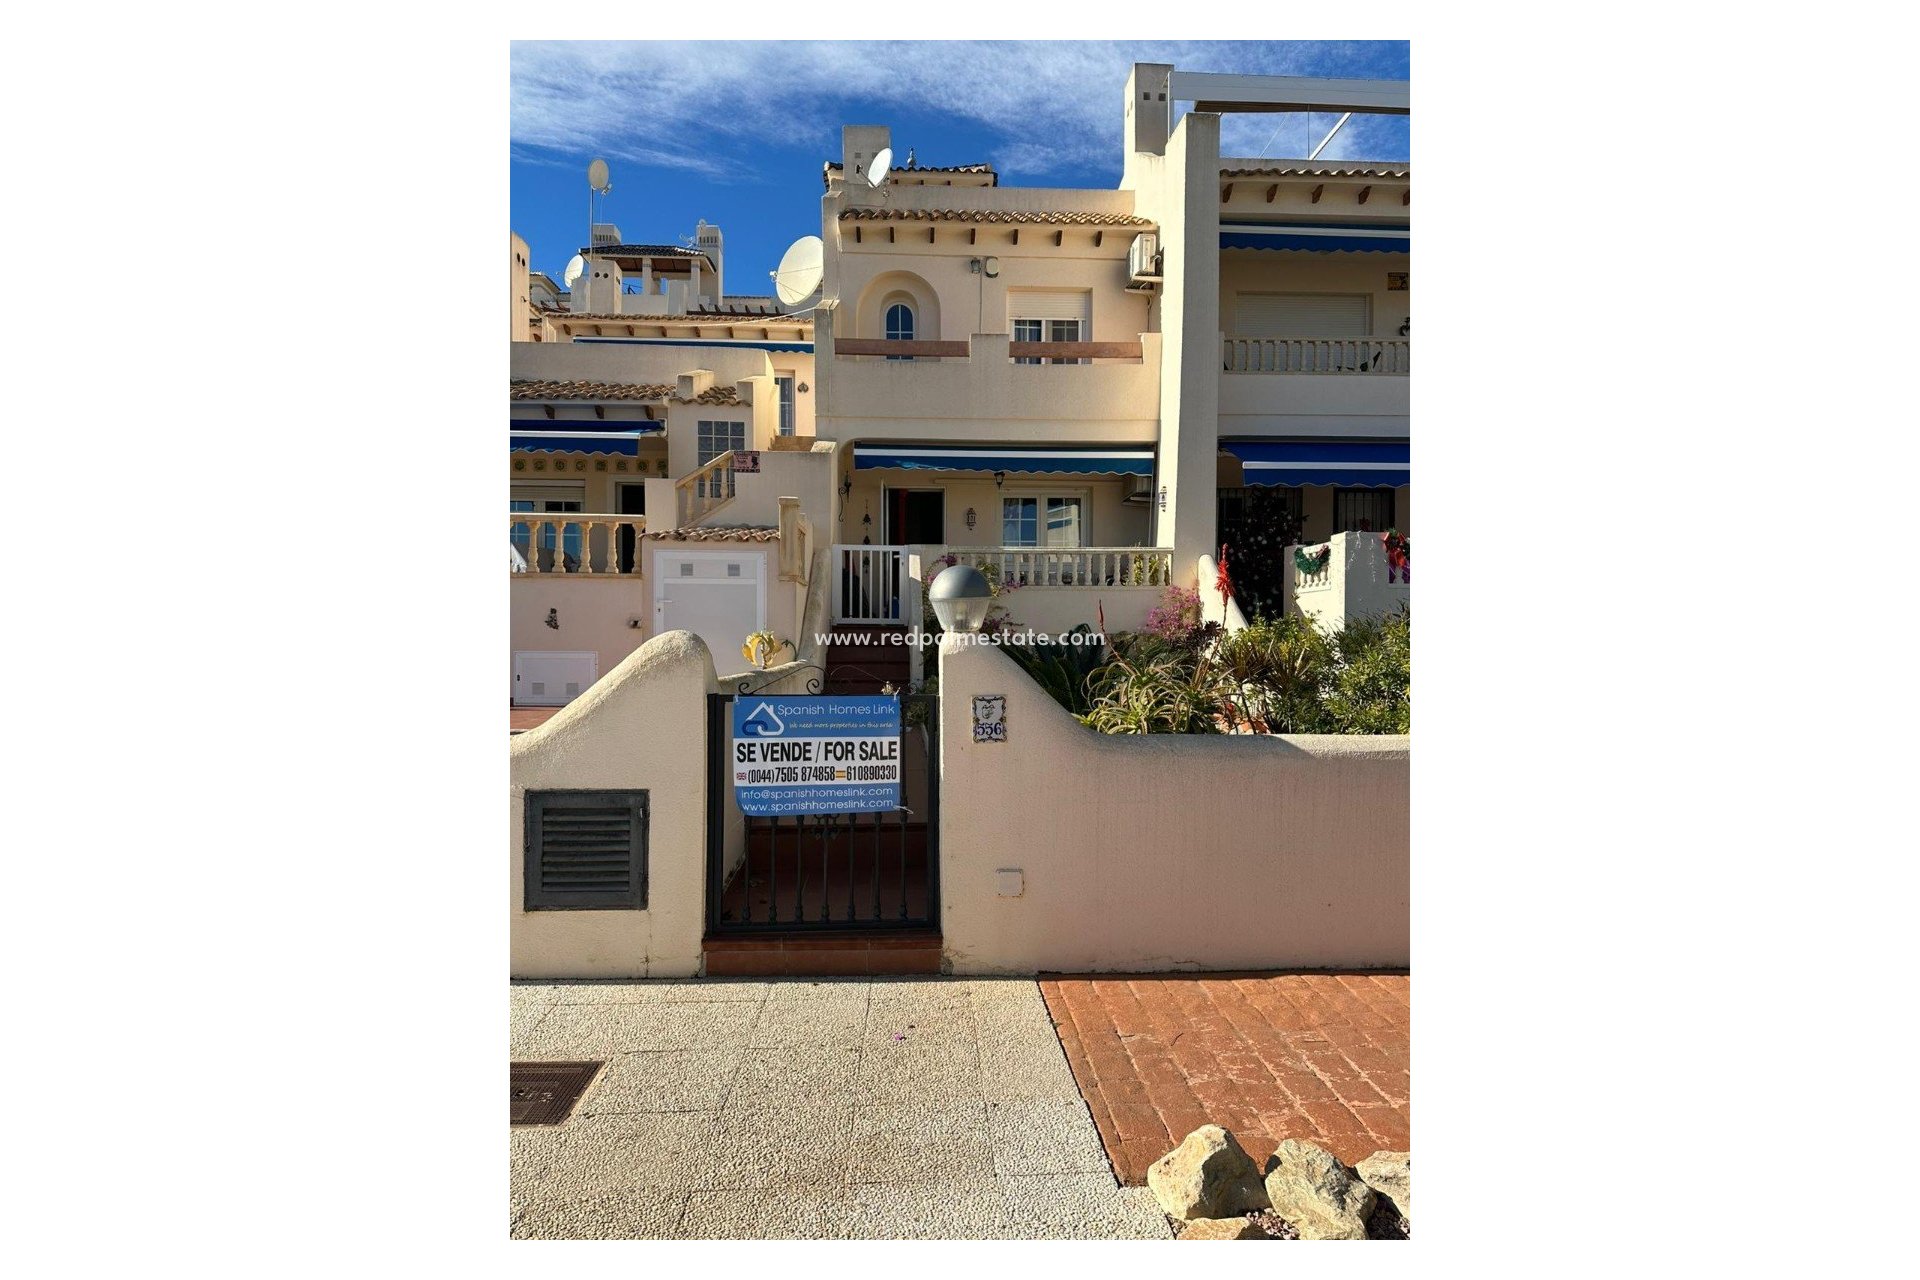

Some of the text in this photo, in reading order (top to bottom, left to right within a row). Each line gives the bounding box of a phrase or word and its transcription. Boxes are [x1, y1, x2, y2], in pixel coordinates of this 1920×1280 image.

[777, 704, 895, 717] Spanish Homes Link
[789, 721, 798, 729] We
[799, 721, 813, 729] need
[830, 721, 858, 731] properties
[867, 721, 879, 729] this
[976, 722, 1002, 736] 556
[736, 740, 898, 763] SE VENDE / FOR SALE
[801, 765, 836, 782] 874858
[846, 764, 897, 781] 610890330
[741, 786, 893, 800] info@spanishhomeslink.com
[742, 799, 894, 812] www.spanishhomeslink.com
